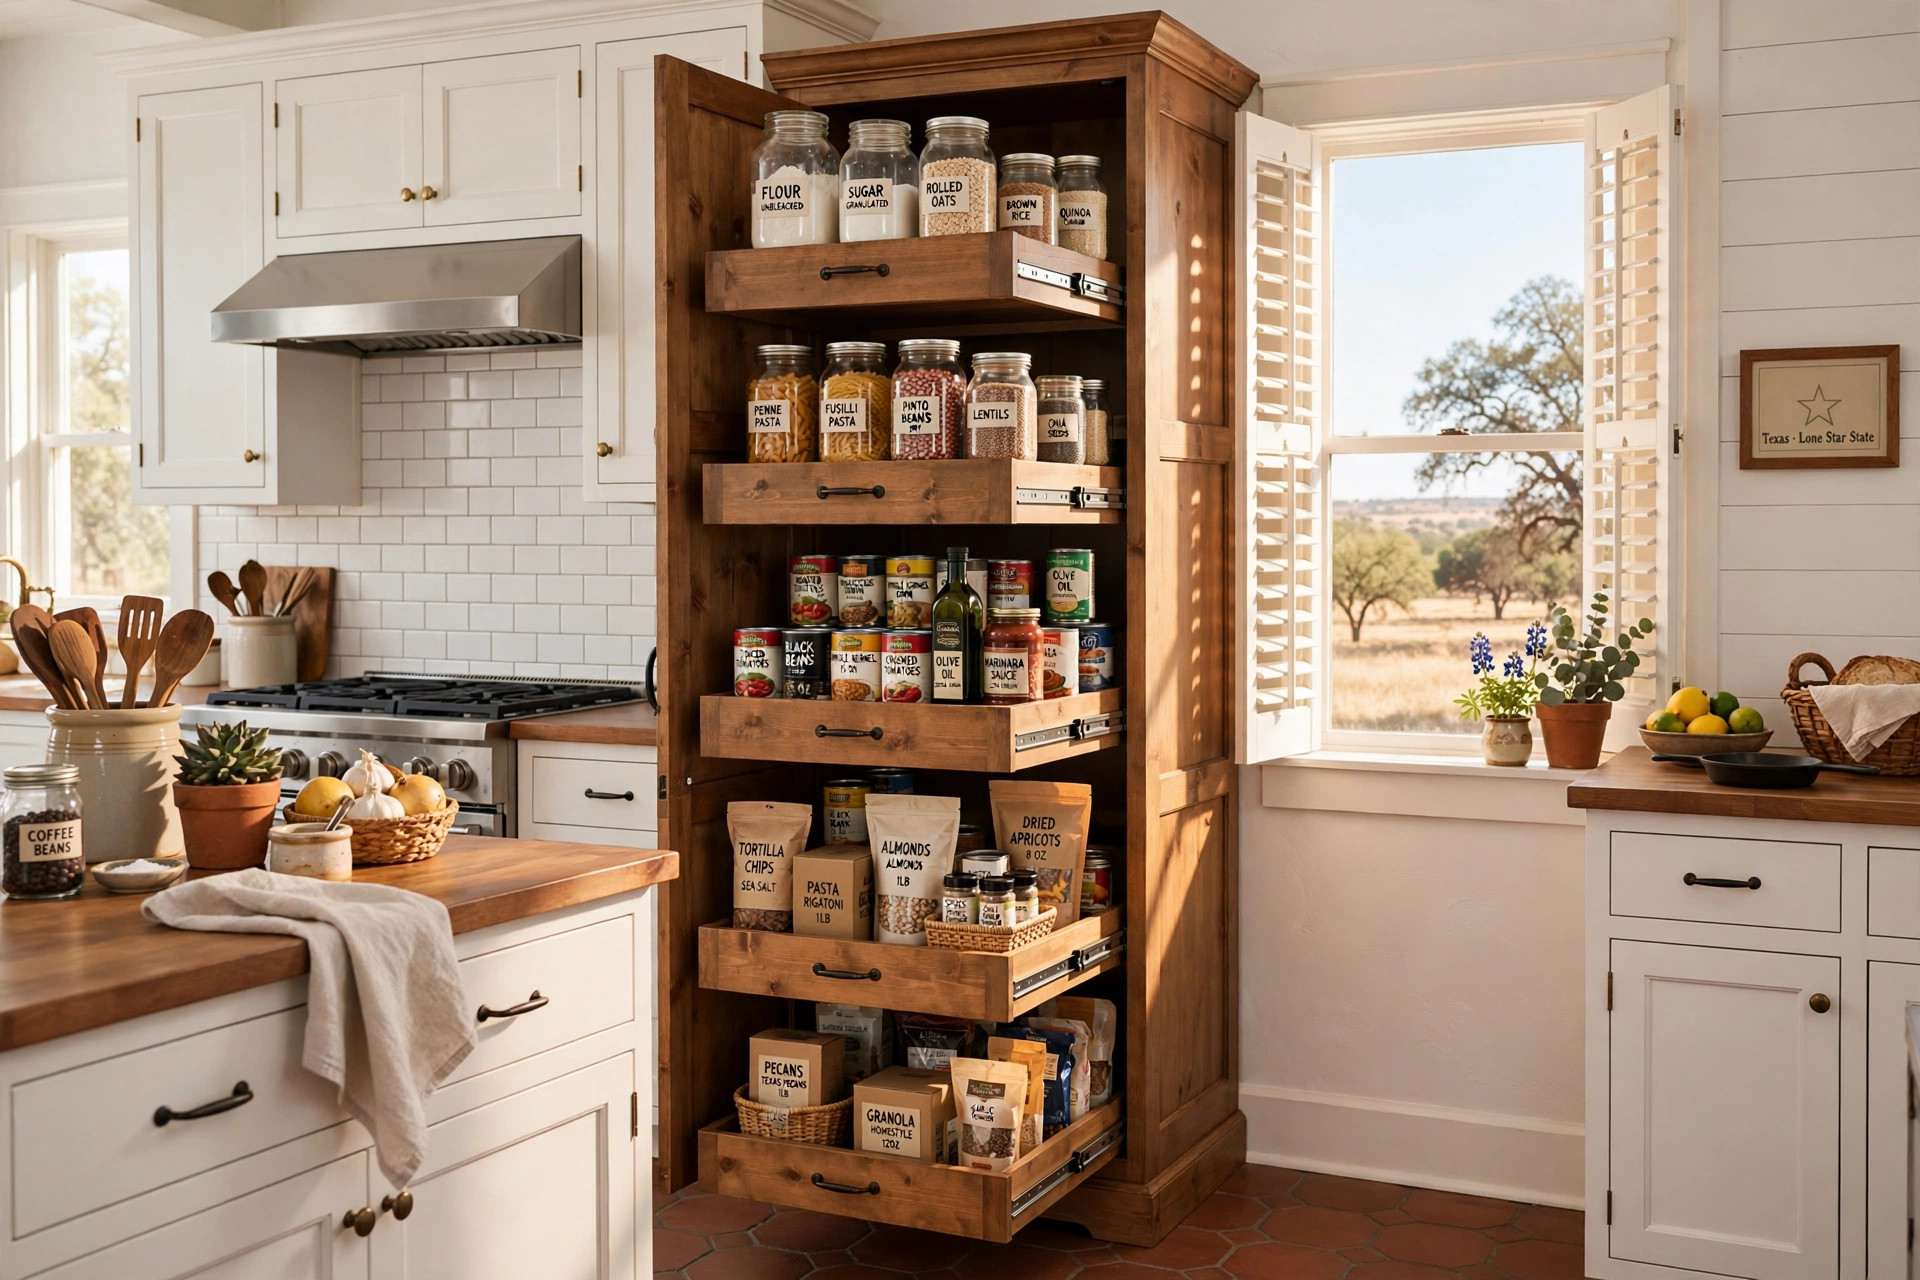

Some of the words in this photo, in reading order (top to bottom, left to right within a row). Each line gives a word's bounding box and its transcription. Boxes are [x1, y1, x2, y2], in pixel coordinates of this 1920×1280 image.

[762, 185, 801, 200] FLOUR
[849, 185, 883, 199] SUGAR
[926, 181, 962, 194] ROLLED
[931, 195, 956, 207] OATS
[1006, 200, 1037, 211] BROWN
[1012, 211, 1031, 221] RICE
[1060, 207, 1091, 219] QUINOA
[754, 405, 782, 416] PENNE
[825, 403, 858, 414] FUSILLI
[903, 400, 929, 411] PINTO
[973, 409, 1010, 420] LENTILS
[755, 417, 781, 427] PASTA
[829, 416, 856, 427] PASTA
[1762, 432, 1789, 444] Texas
[1799, 432, 1823, 443] Lone
[1826, 431, 1846, 443] Star
[1849, 430, 1875, 443] State
[936, 656, 960, 667] OLIVE
[942, 669, 955, 680] OIL
[1022, 816, 1056, 830] DRIED
[27, 826, 74, 842] COFFEE
[1010, 832, 1061, 847] APRICOTS
[34, 842, 71, 856] BEANS
[739, 842, 784, 857] TORTILLA
[881, 840, 931, 857] ALMONDS
[1026, 850, 1031, 860] 8
[1034, 850, 1047, 860] OZ
[745, 860, 774, 874] CHIPS
[741, 880, 756, 892] SEA
[758, 881, 776, 893] SALT
[896, 876, 910, 887] 1LB
[807, 881, 839, 896] PASTA
[803, 897, 844, 910] RIGATONI
[816, 913, 831, 924] 1LB
[764, 1061, 803, 1078] PECANS
[761, 1076, 782, 1087] TEXAS
[867, 1109, 915, 1128] GRANOLA
